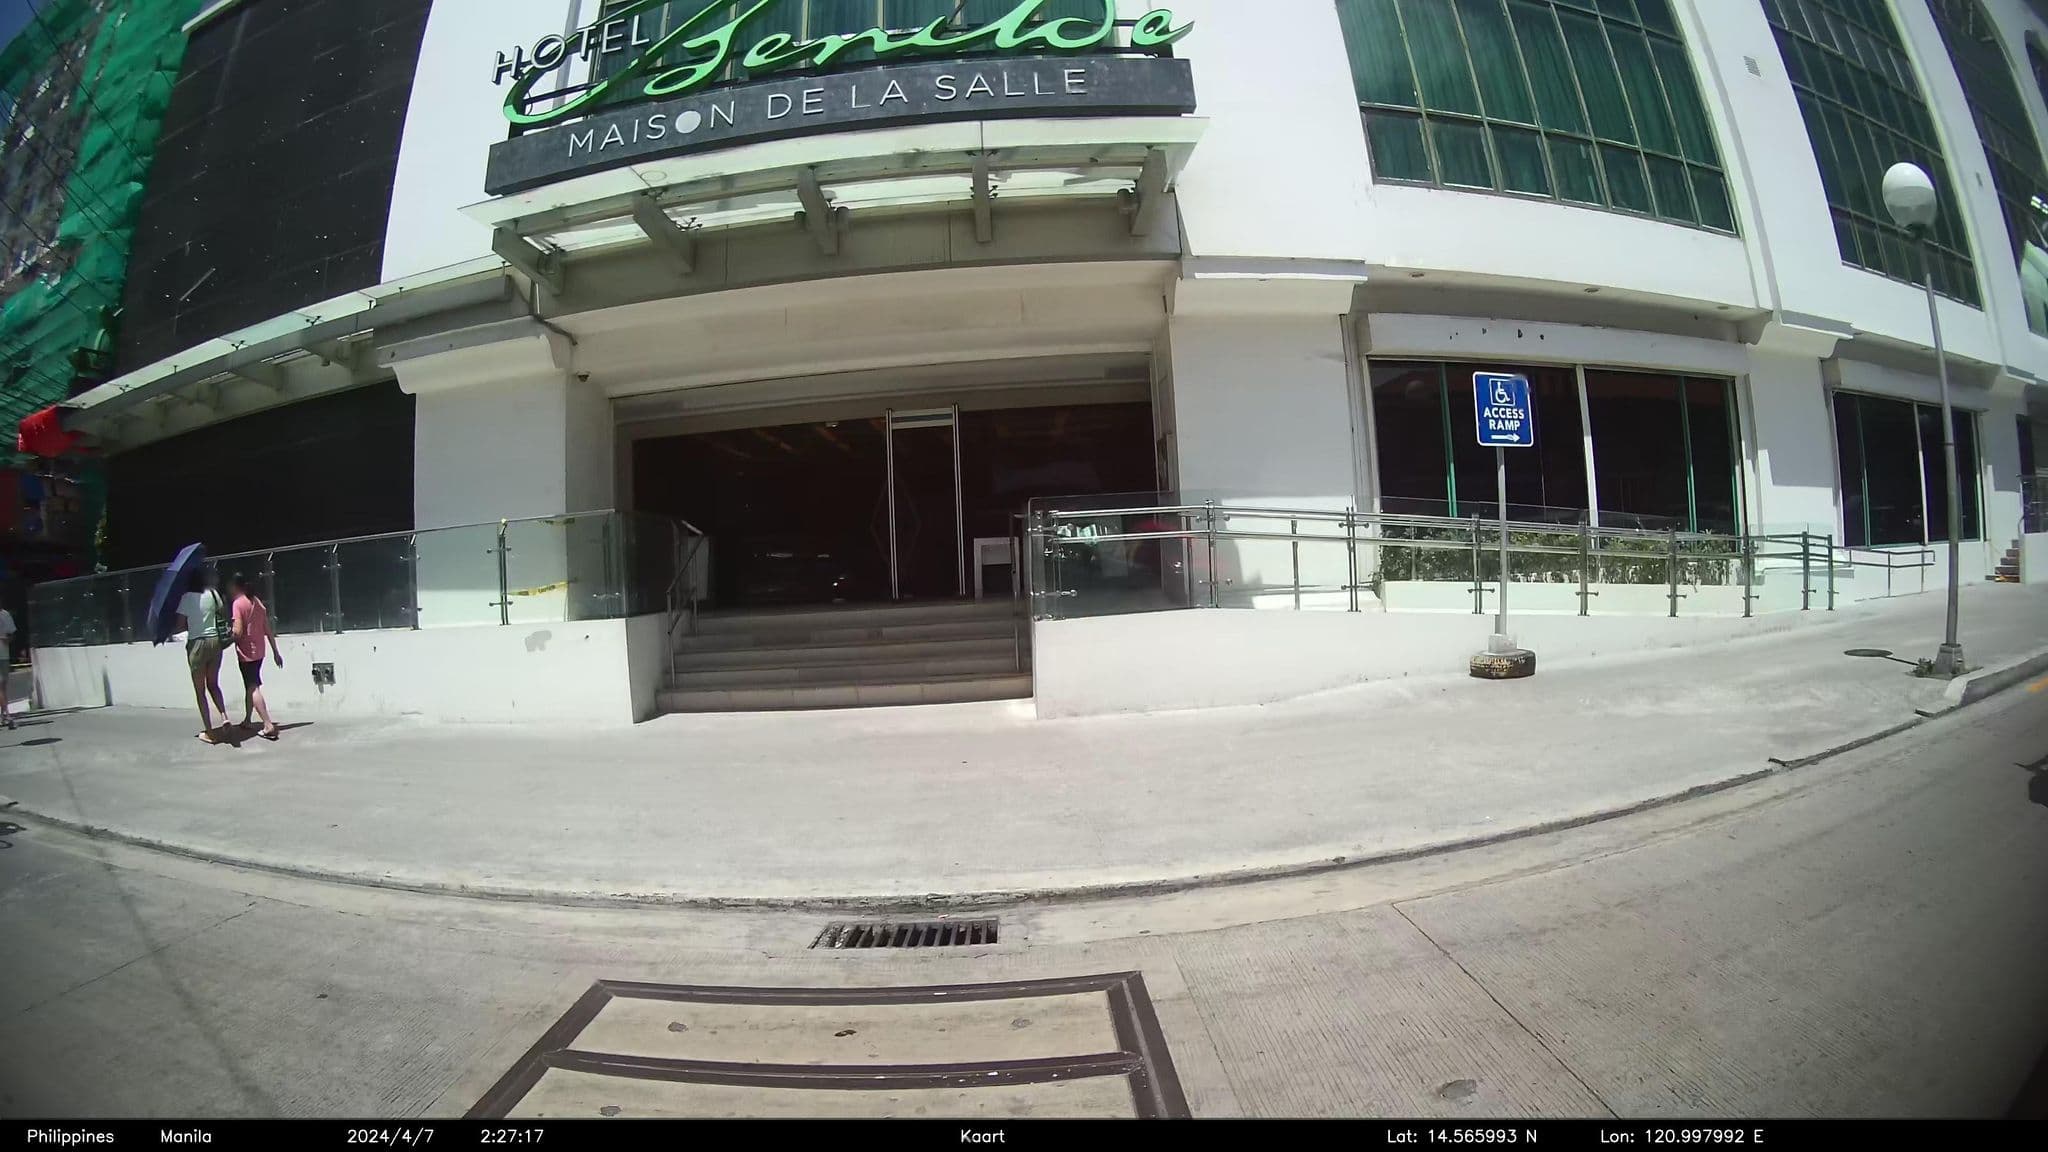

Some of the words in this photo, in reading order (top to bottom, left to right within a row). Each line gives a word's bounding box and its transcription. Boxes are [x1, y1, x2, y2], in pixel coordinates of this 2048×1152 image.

[492, 14, 650, 85] HOTEL
[568, 100, 736, 158] MAISON
[766, 88, 825, 120] DE
[851, 79, 909, 110] LA
[934, 68, 1088, 101] SALLE
[1483, 406, 1525, 419] ACCESS
[1489, 419, 1521, 431] RAMP
